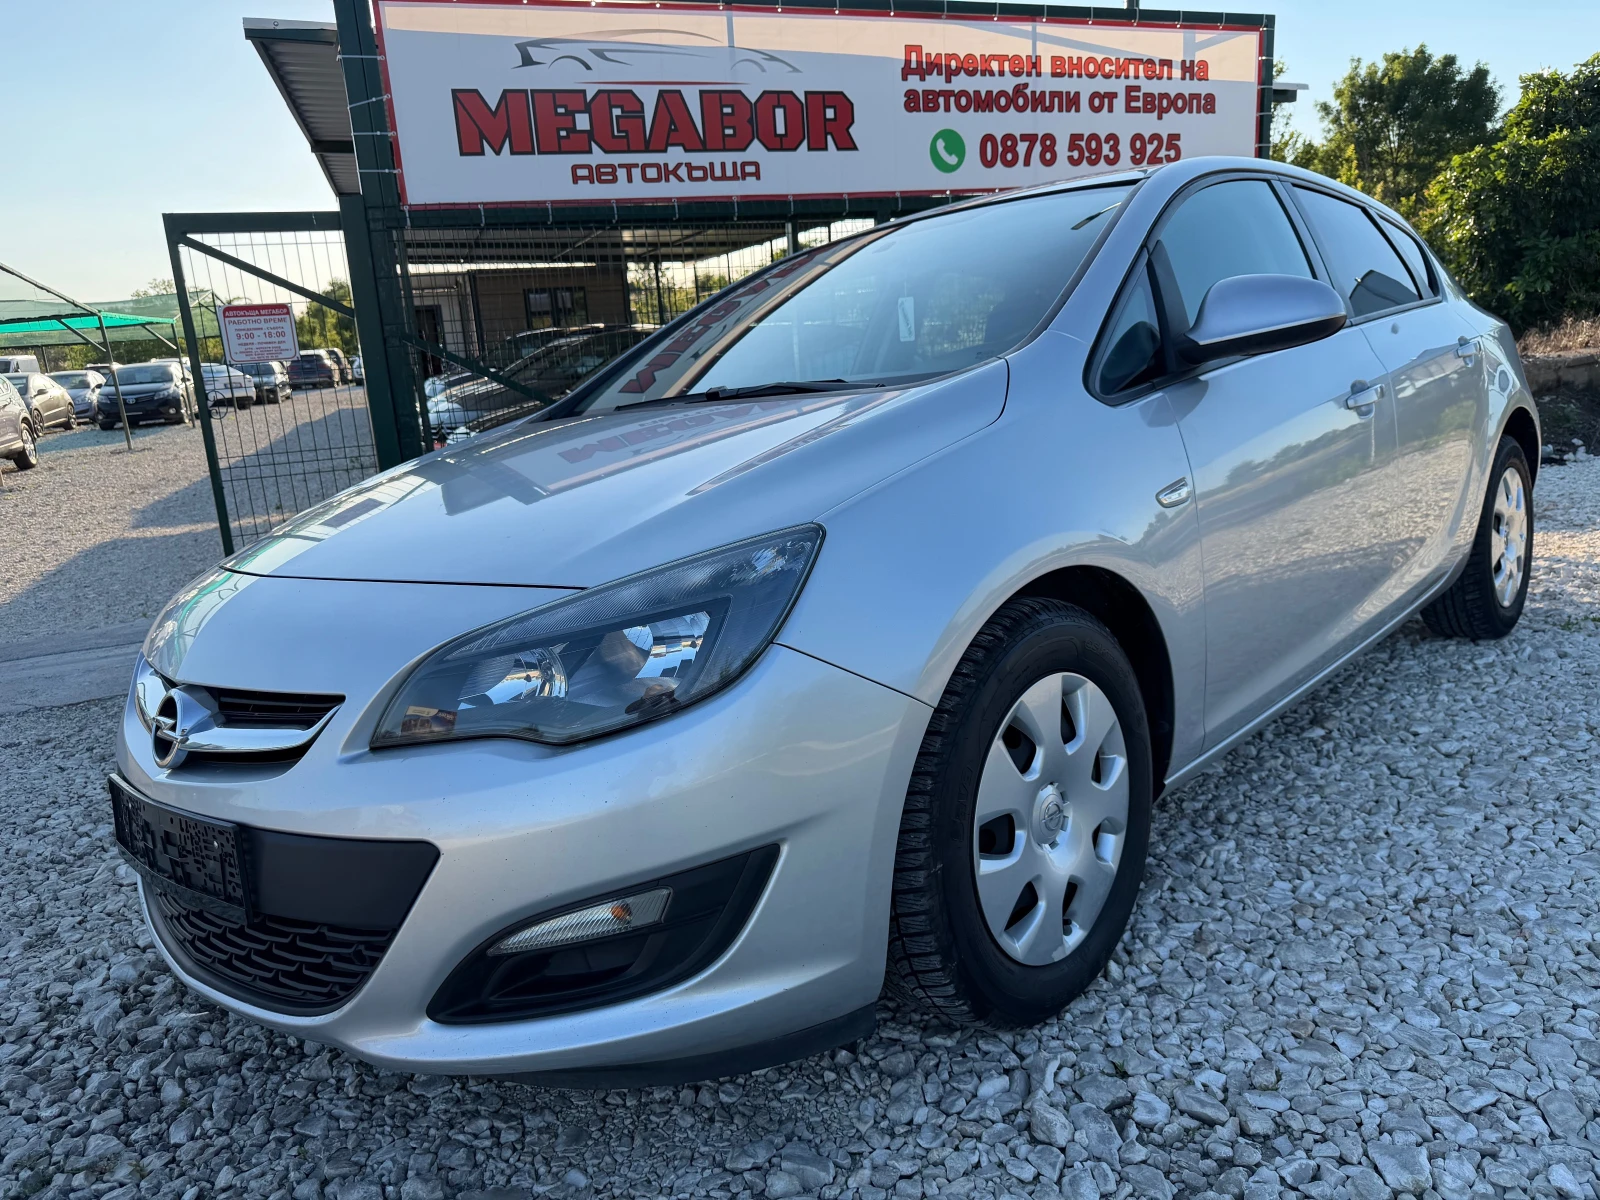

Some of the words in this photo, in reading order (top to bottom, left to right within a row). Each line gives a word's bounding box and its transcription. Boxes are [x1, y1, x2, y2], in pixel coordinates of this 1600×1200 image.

[901, 45, 1042, 83] Директен
[1050, 54, 1173, 81] вносител
[1180, 58, 1210, 82] на
[903, 83, 1081, 114] автомобили
[1088, 91, 1118, 115] от
[1125, 85, 1217, 120] Европа
[451, 88, 859, 157] MEGABOR
[979, 133, 1057, 169] 0878
[1067, 133, 1121, 167] 593
[1129, 132, 1182, 166] 925
[571, 160, 761, 185] АВТОКЪЩА
[228, 318, 262, 326] РАБОТНО
[263, 316, 288, 324] ВРЕМЕ
[236, 332, 255, 340] 9:00
